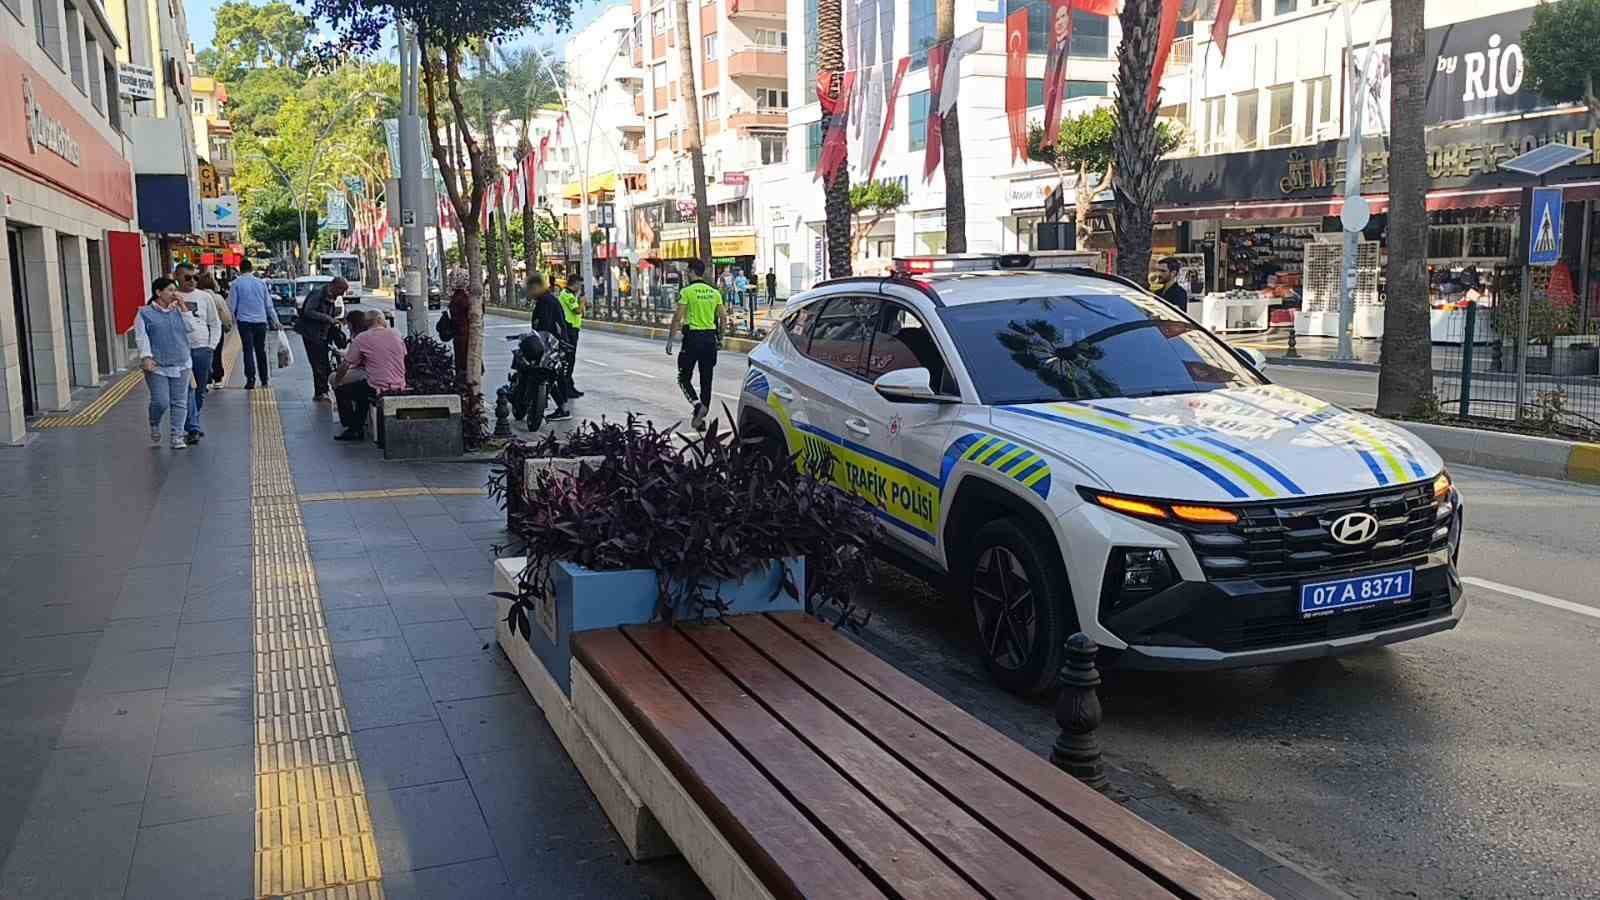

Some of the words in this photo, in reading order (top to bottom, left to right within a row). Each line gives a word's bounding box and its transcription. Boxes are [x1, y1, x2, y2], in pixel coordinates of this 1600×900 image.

[1437, 55, 1458, 74] by
[1462, 33, 1524, 102] RİO
[845, 461, 887, 500] TRAFİK
[891, 481, 933, 523] POLİSİ
[1313, 586, 1337, 605] 07
[1341, 583, 1356, 602] A
[1361, 576, 1403, 598] 8371
